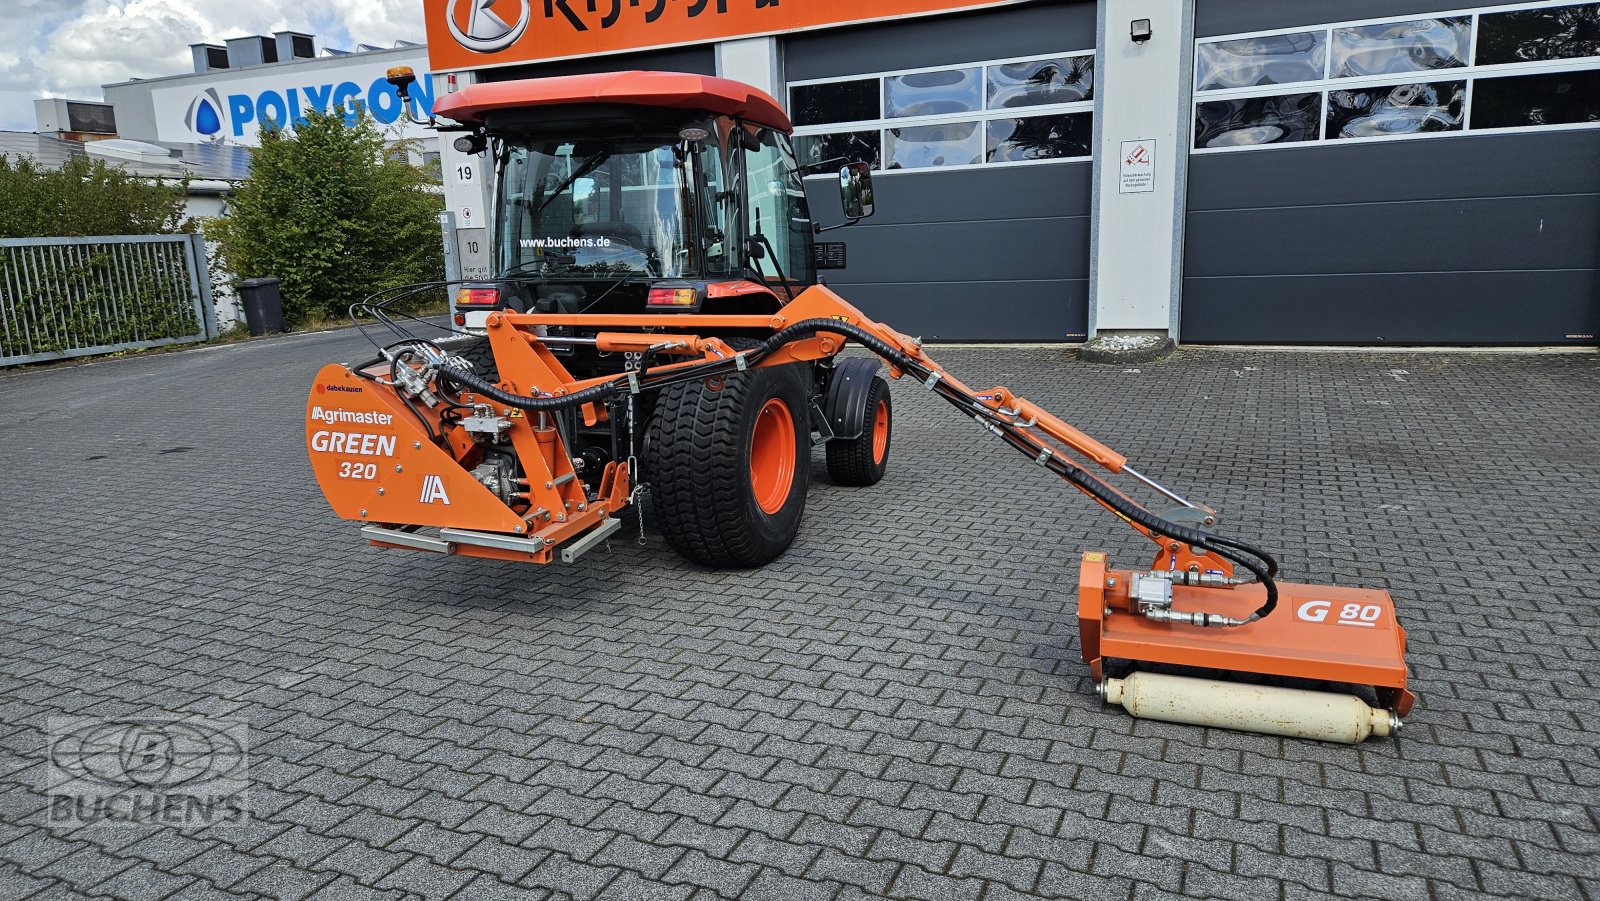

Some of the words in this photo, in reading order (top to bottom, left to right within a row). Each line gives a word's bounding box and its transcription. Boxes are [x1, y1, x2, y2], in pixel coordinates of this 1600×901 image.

[228, 73, 435, 137] POLYGON
[457, 166, 472, 180] 19
[467, 241, 479, 254] 10
[519, 235, 611, 248] www.buchens.de
[326, 384, 363, 393] dabekausen
[314, 406, 393, 425] Agrimaster
[311, 430, 397, 457] GREEN
[338, 461, 377, 480] 320
[1297, 600, 1332, 622] G
[1339, 603, 1382, 621] 80
